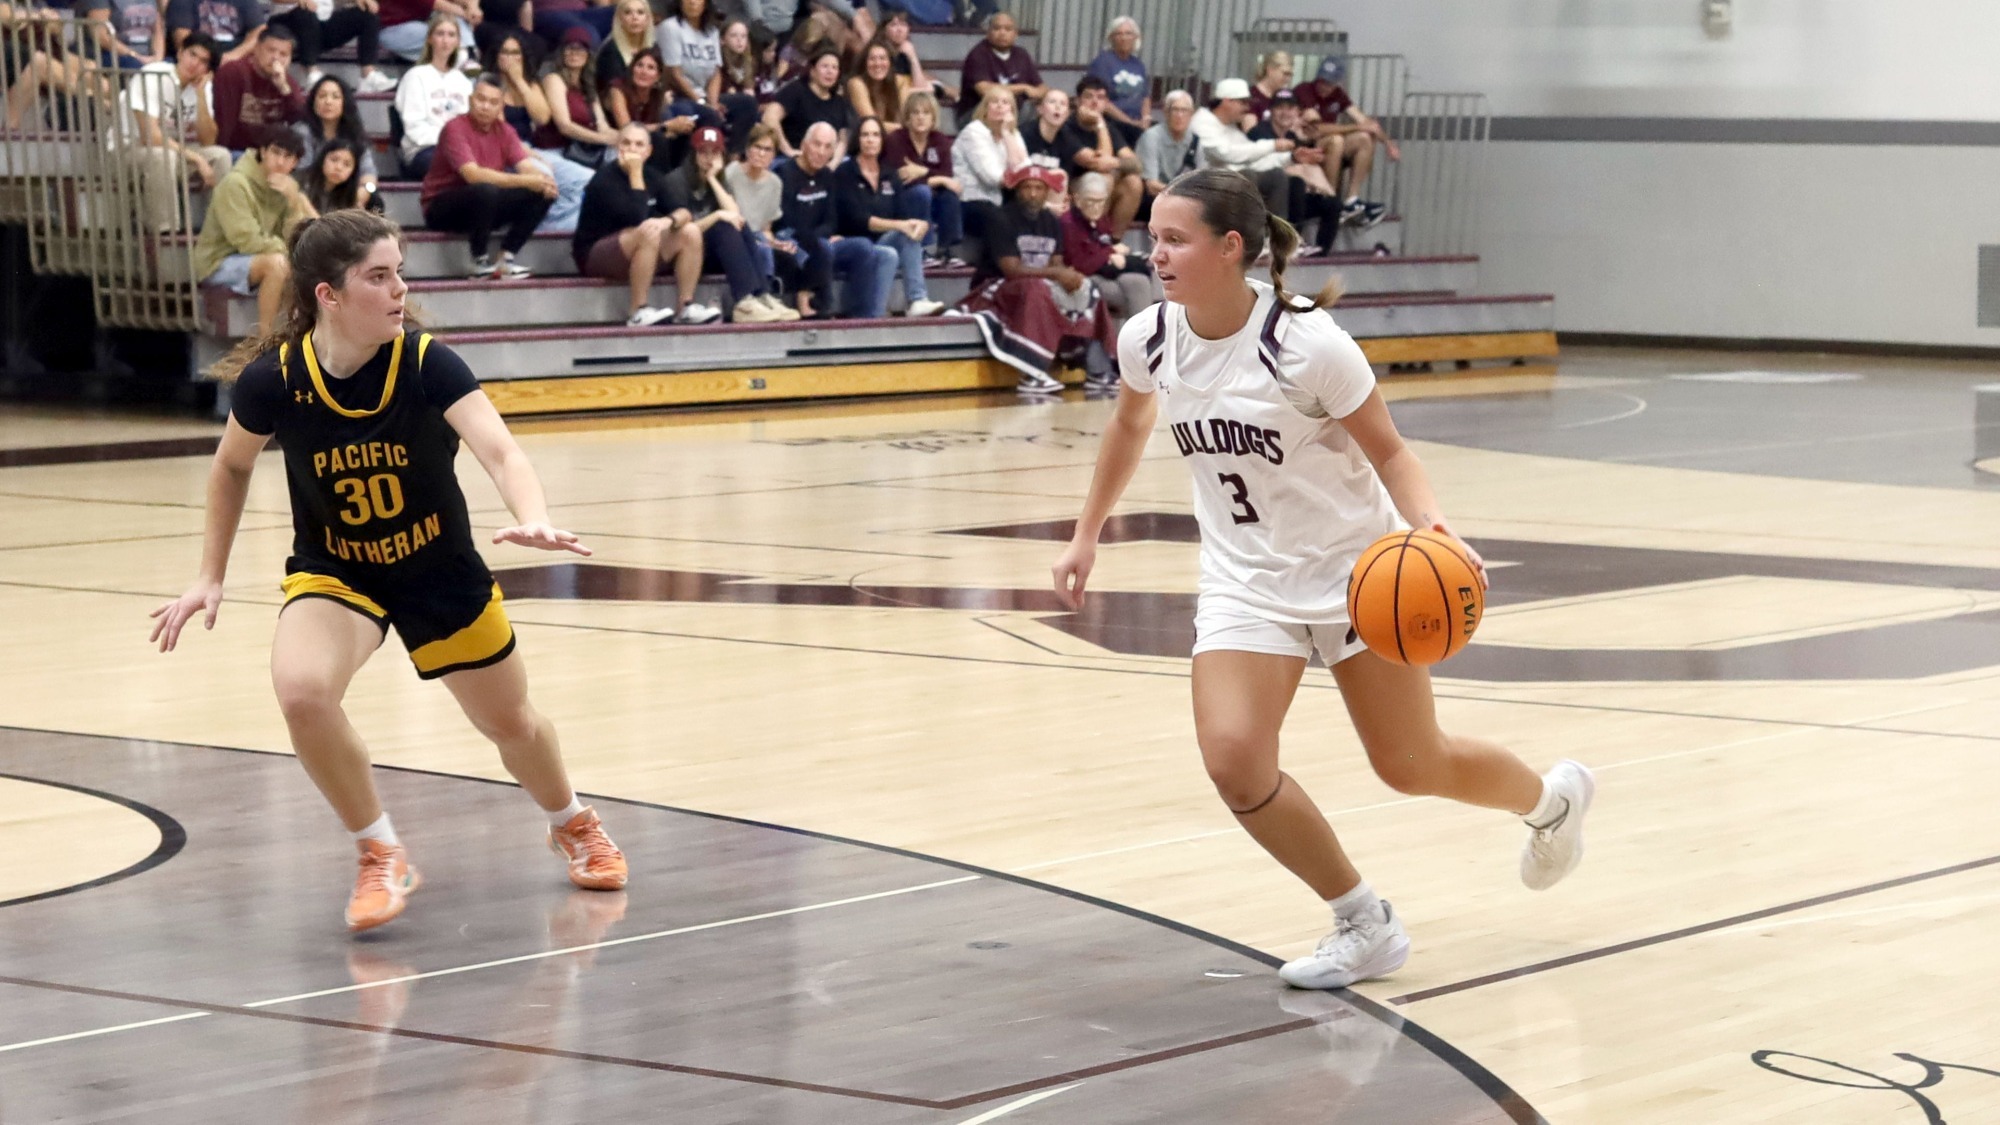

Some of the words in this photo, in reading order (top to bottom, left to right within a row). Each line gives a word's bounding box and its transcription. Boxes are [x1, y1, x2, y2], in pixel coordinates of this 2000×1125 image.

[313, 441, 409, 478] PACIFIC
[1170, 418, 1284, 466] ULLDOGS
[334, 473, 405, 526] 30
[1217, 472, 1260, 525] 3
[324, 513, 441, 564] LUTHERAN
